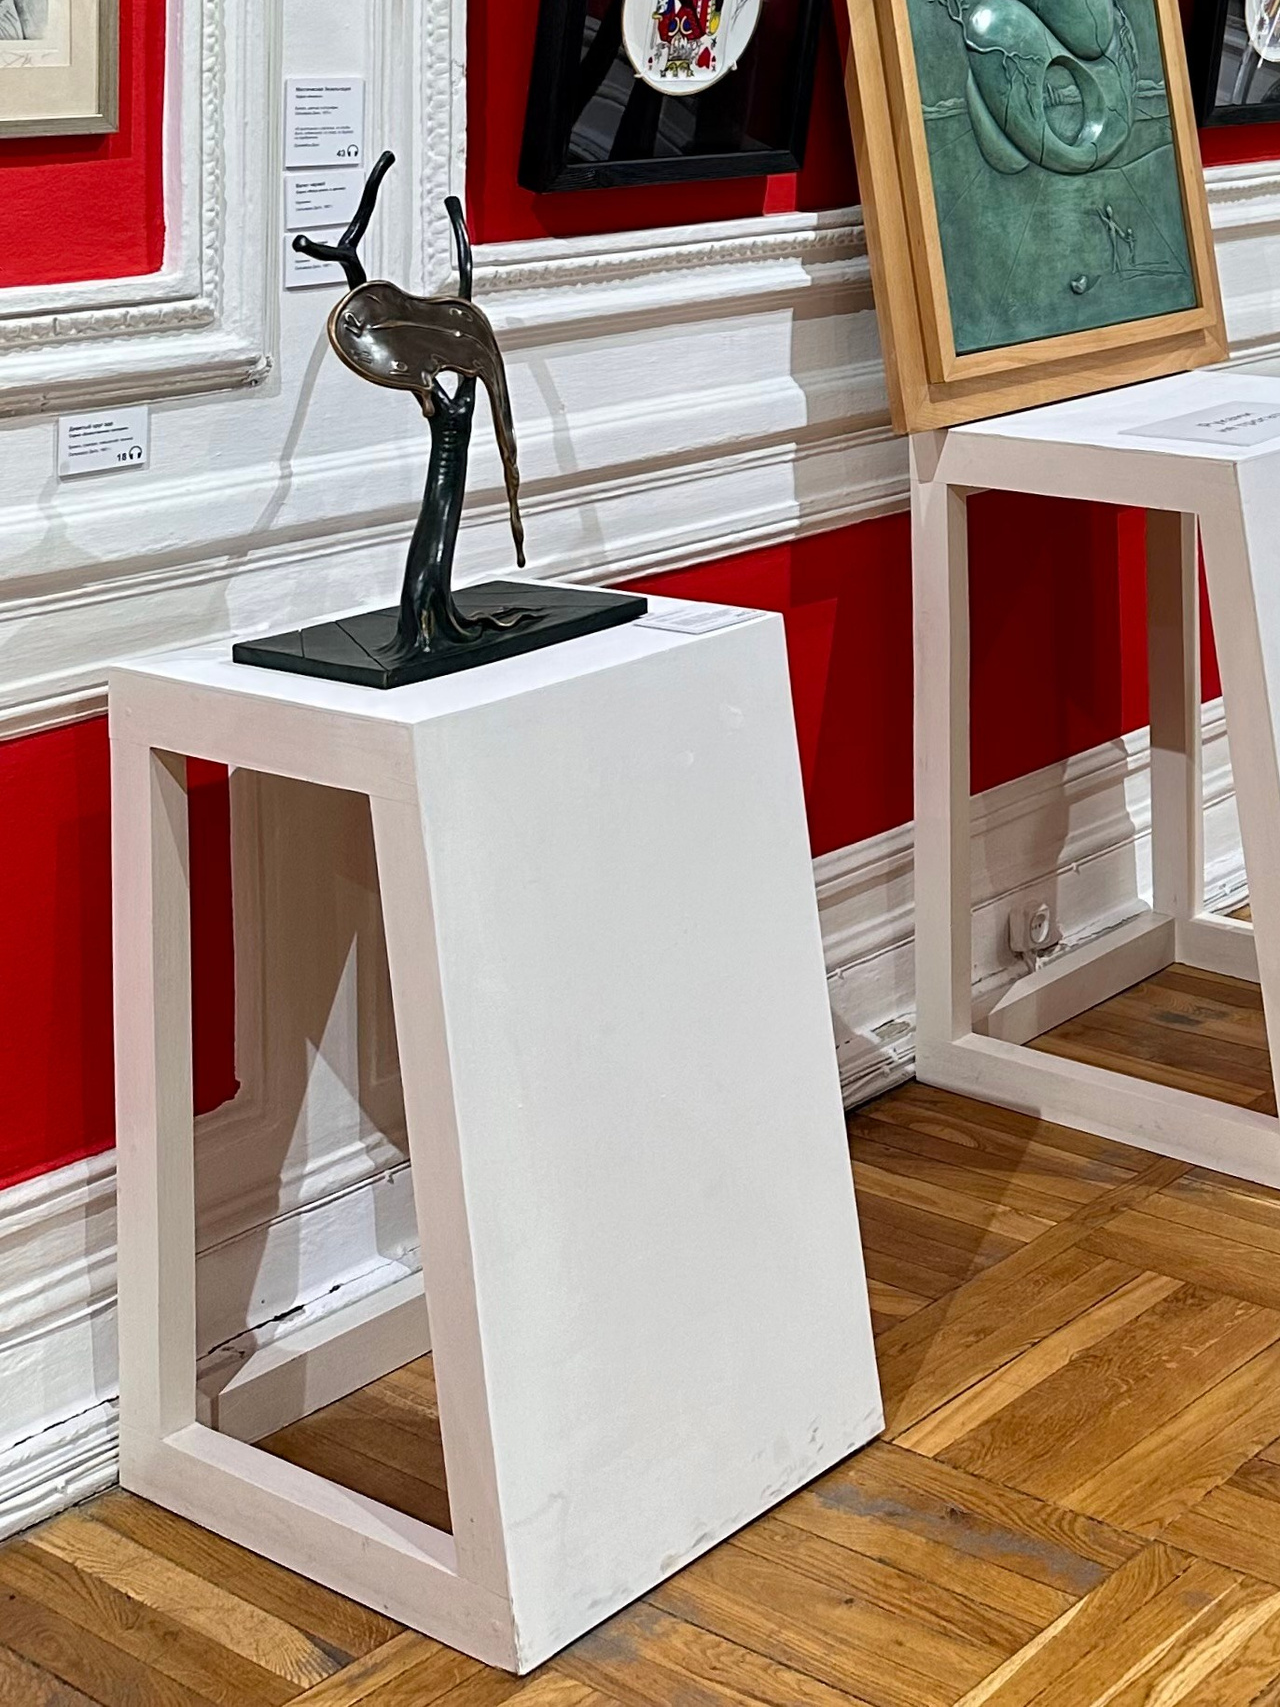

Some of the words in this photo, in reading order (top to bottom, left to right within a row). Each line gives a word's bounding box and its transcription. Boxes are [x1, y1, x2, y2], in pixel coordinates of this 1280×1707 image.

[336, 149, 346, 158] 43
[344, 312, 364, 338] 12
[117, 453, 127, 462] 18
